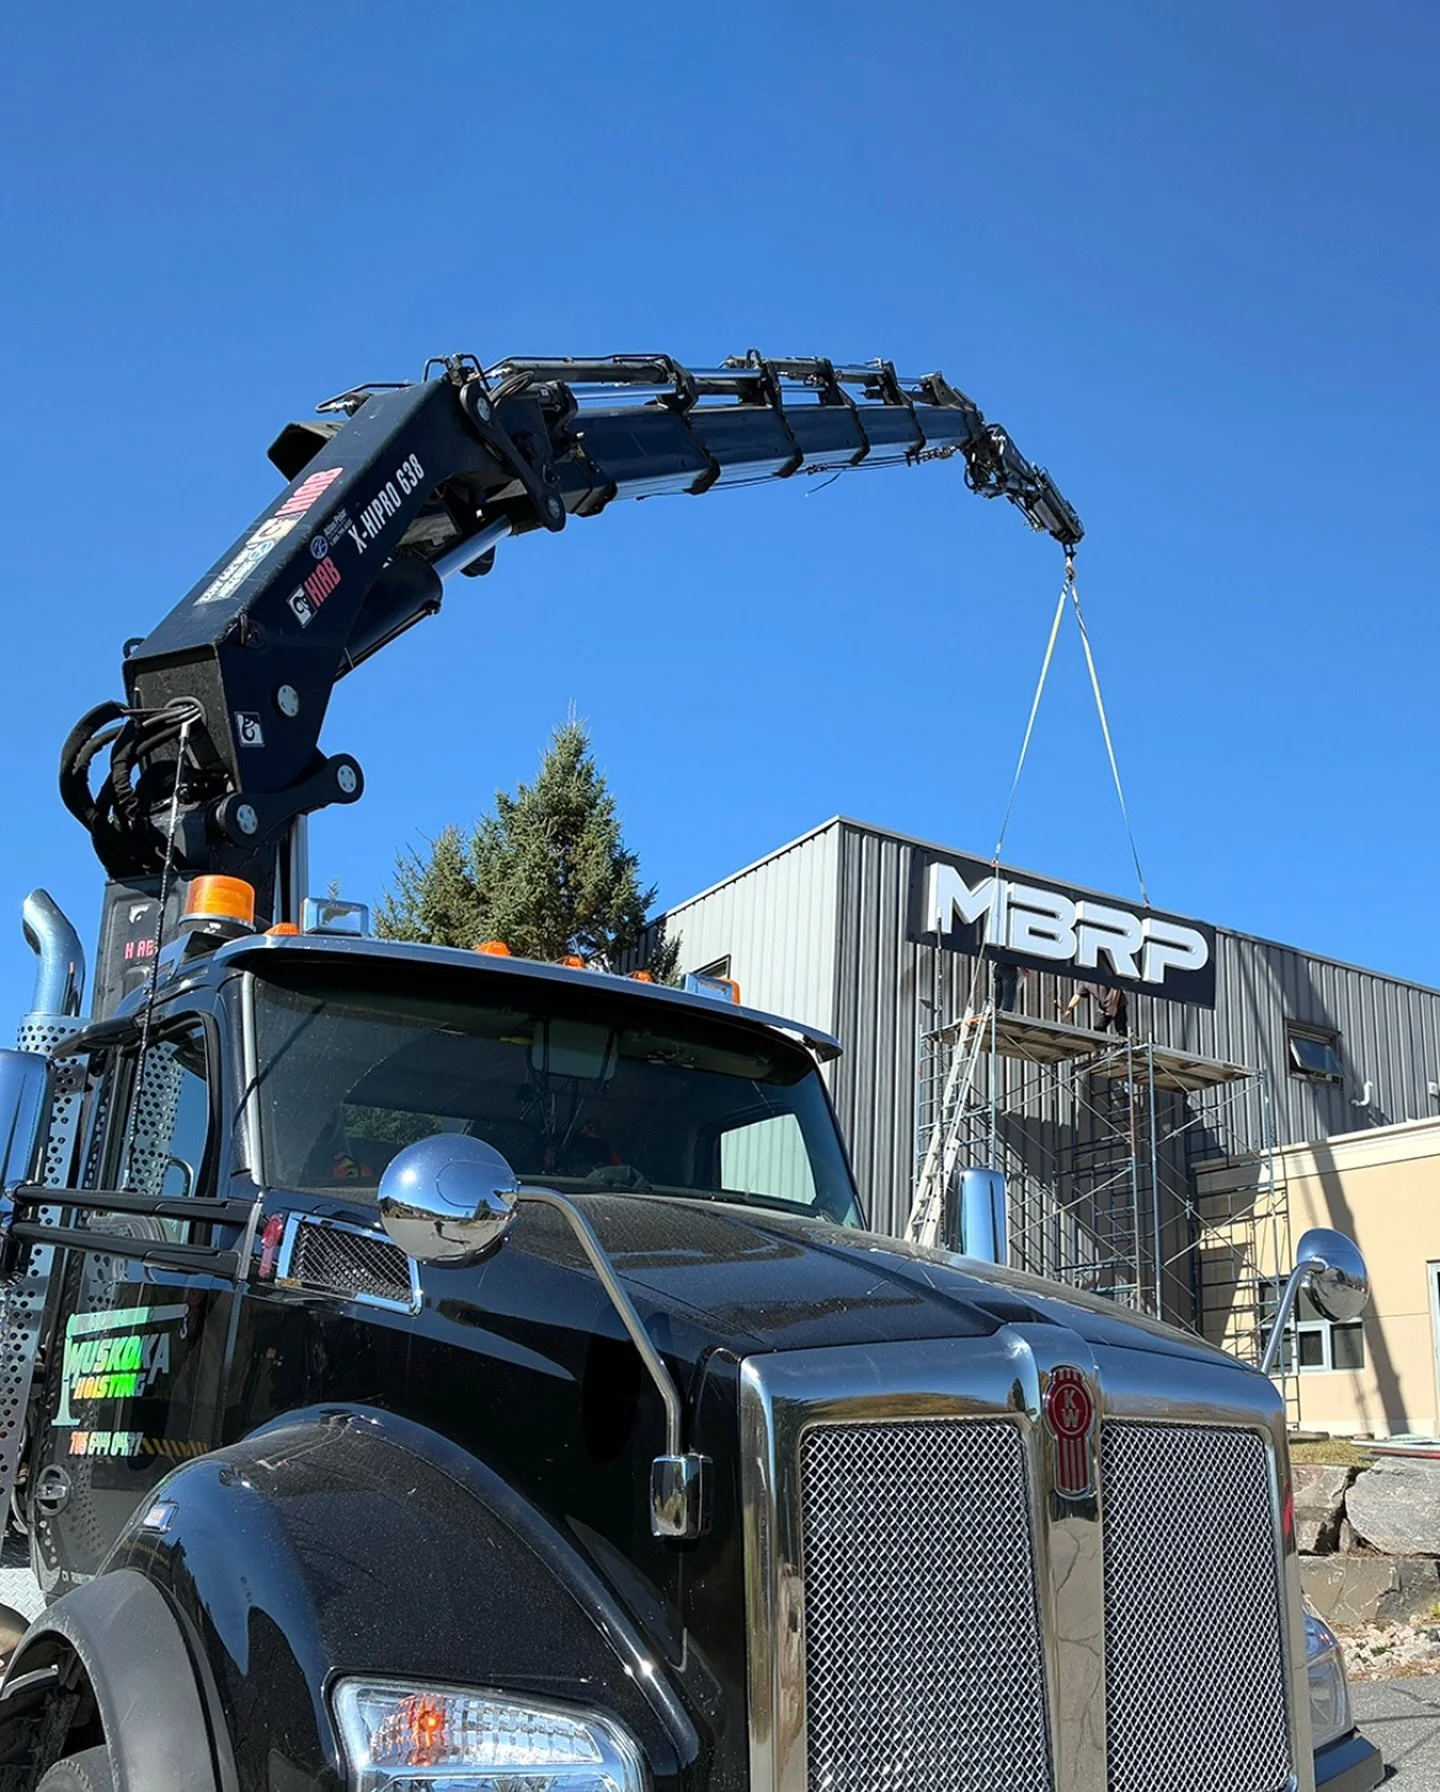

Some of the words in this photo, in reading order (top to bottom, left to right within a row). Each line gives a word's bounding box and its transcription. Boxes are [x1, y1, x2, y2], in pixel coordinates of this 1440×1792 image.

[349, 481, 401, 554] X-HIPRO
[396, 453, 425, 495] 638
[304, 557, 342, 607] HIAB
[927, 862, 1209, 983] MBRP
[69, 1333, 170, 1388] MUSKOKA
[73, 1374, 146, 1399] HOISTING
